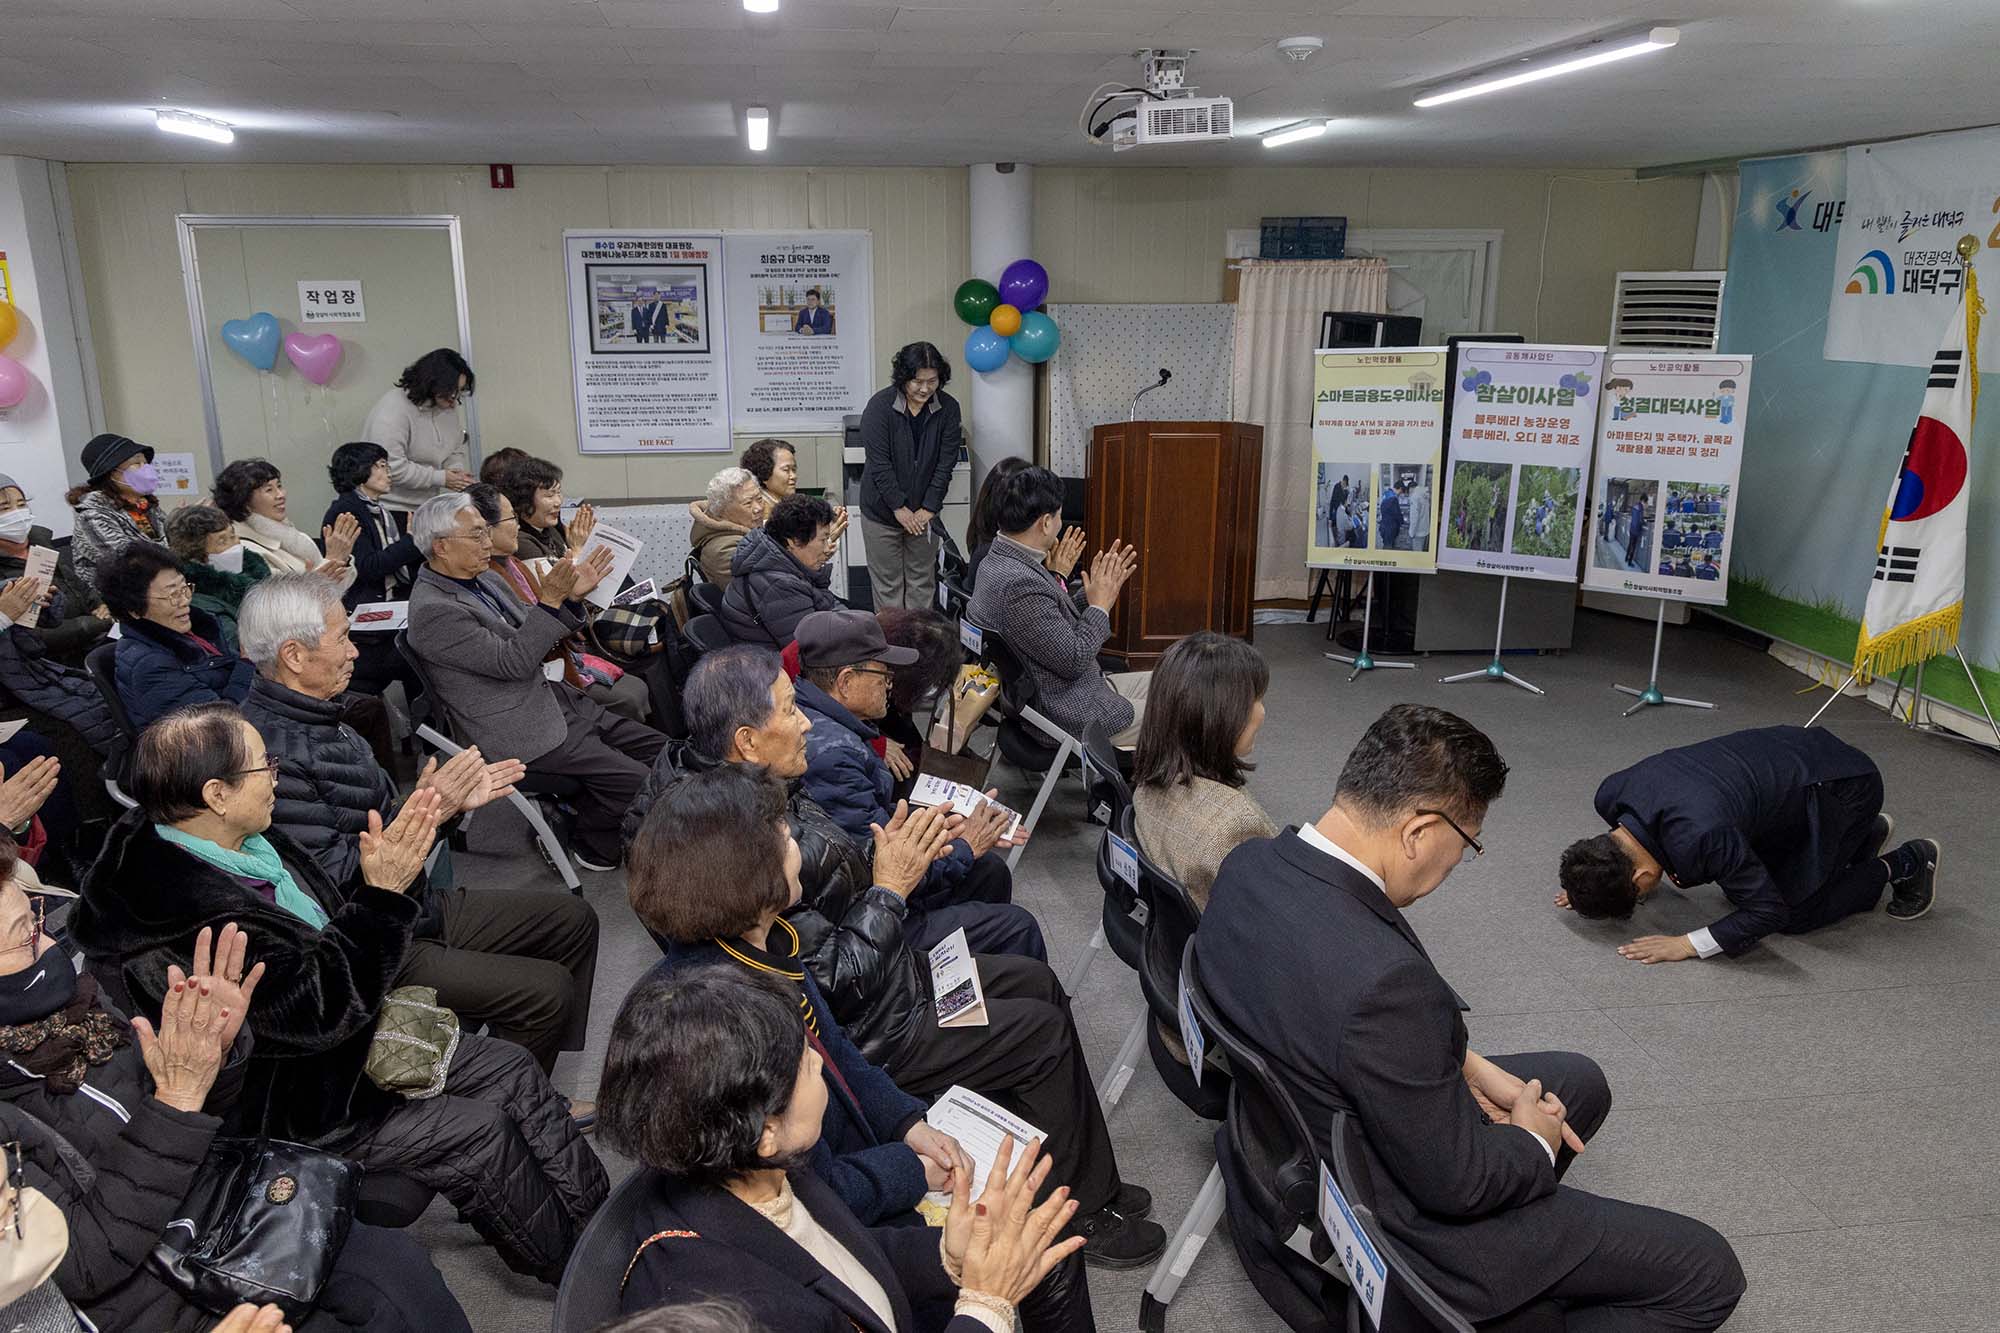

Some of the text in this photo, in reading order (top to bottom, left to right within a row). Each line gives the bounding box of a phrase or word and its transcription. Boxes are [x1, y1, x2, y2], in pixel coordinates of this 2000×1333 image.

[1862, 219, 1873, 231] 내
[1898, 210, 1929, 243] 즐거운
[1932, 210, 1965, 229] 대덕구
[788, 254, 830, 264] 대덕구청장
[1903, 250, 1963, 266] 대전광역시
[1902, 269, 1962, 295] 대덕구
[306, 290, 355, 304] 작업장
[1317, 389, 1443, 402] 스마트금융도우미사업
[1477, 383, 1575, 407] 참살이사업
[1620, 396, 1721, 416] 청결대덕사업
[1475, 414, 1570, 429] 블루베리 농장운영
[1514, 431, 1536, 443] 오디
[1556, 434, 1580, 446] 제조
[1607, 431, 1652, 441] 아파트단지
[1655, 432, 1664, 442] 및
[1704, 434, 1733, 445] 골목길
[1616, 444, 1719, 457] 재활용품 재분리 및 정리
